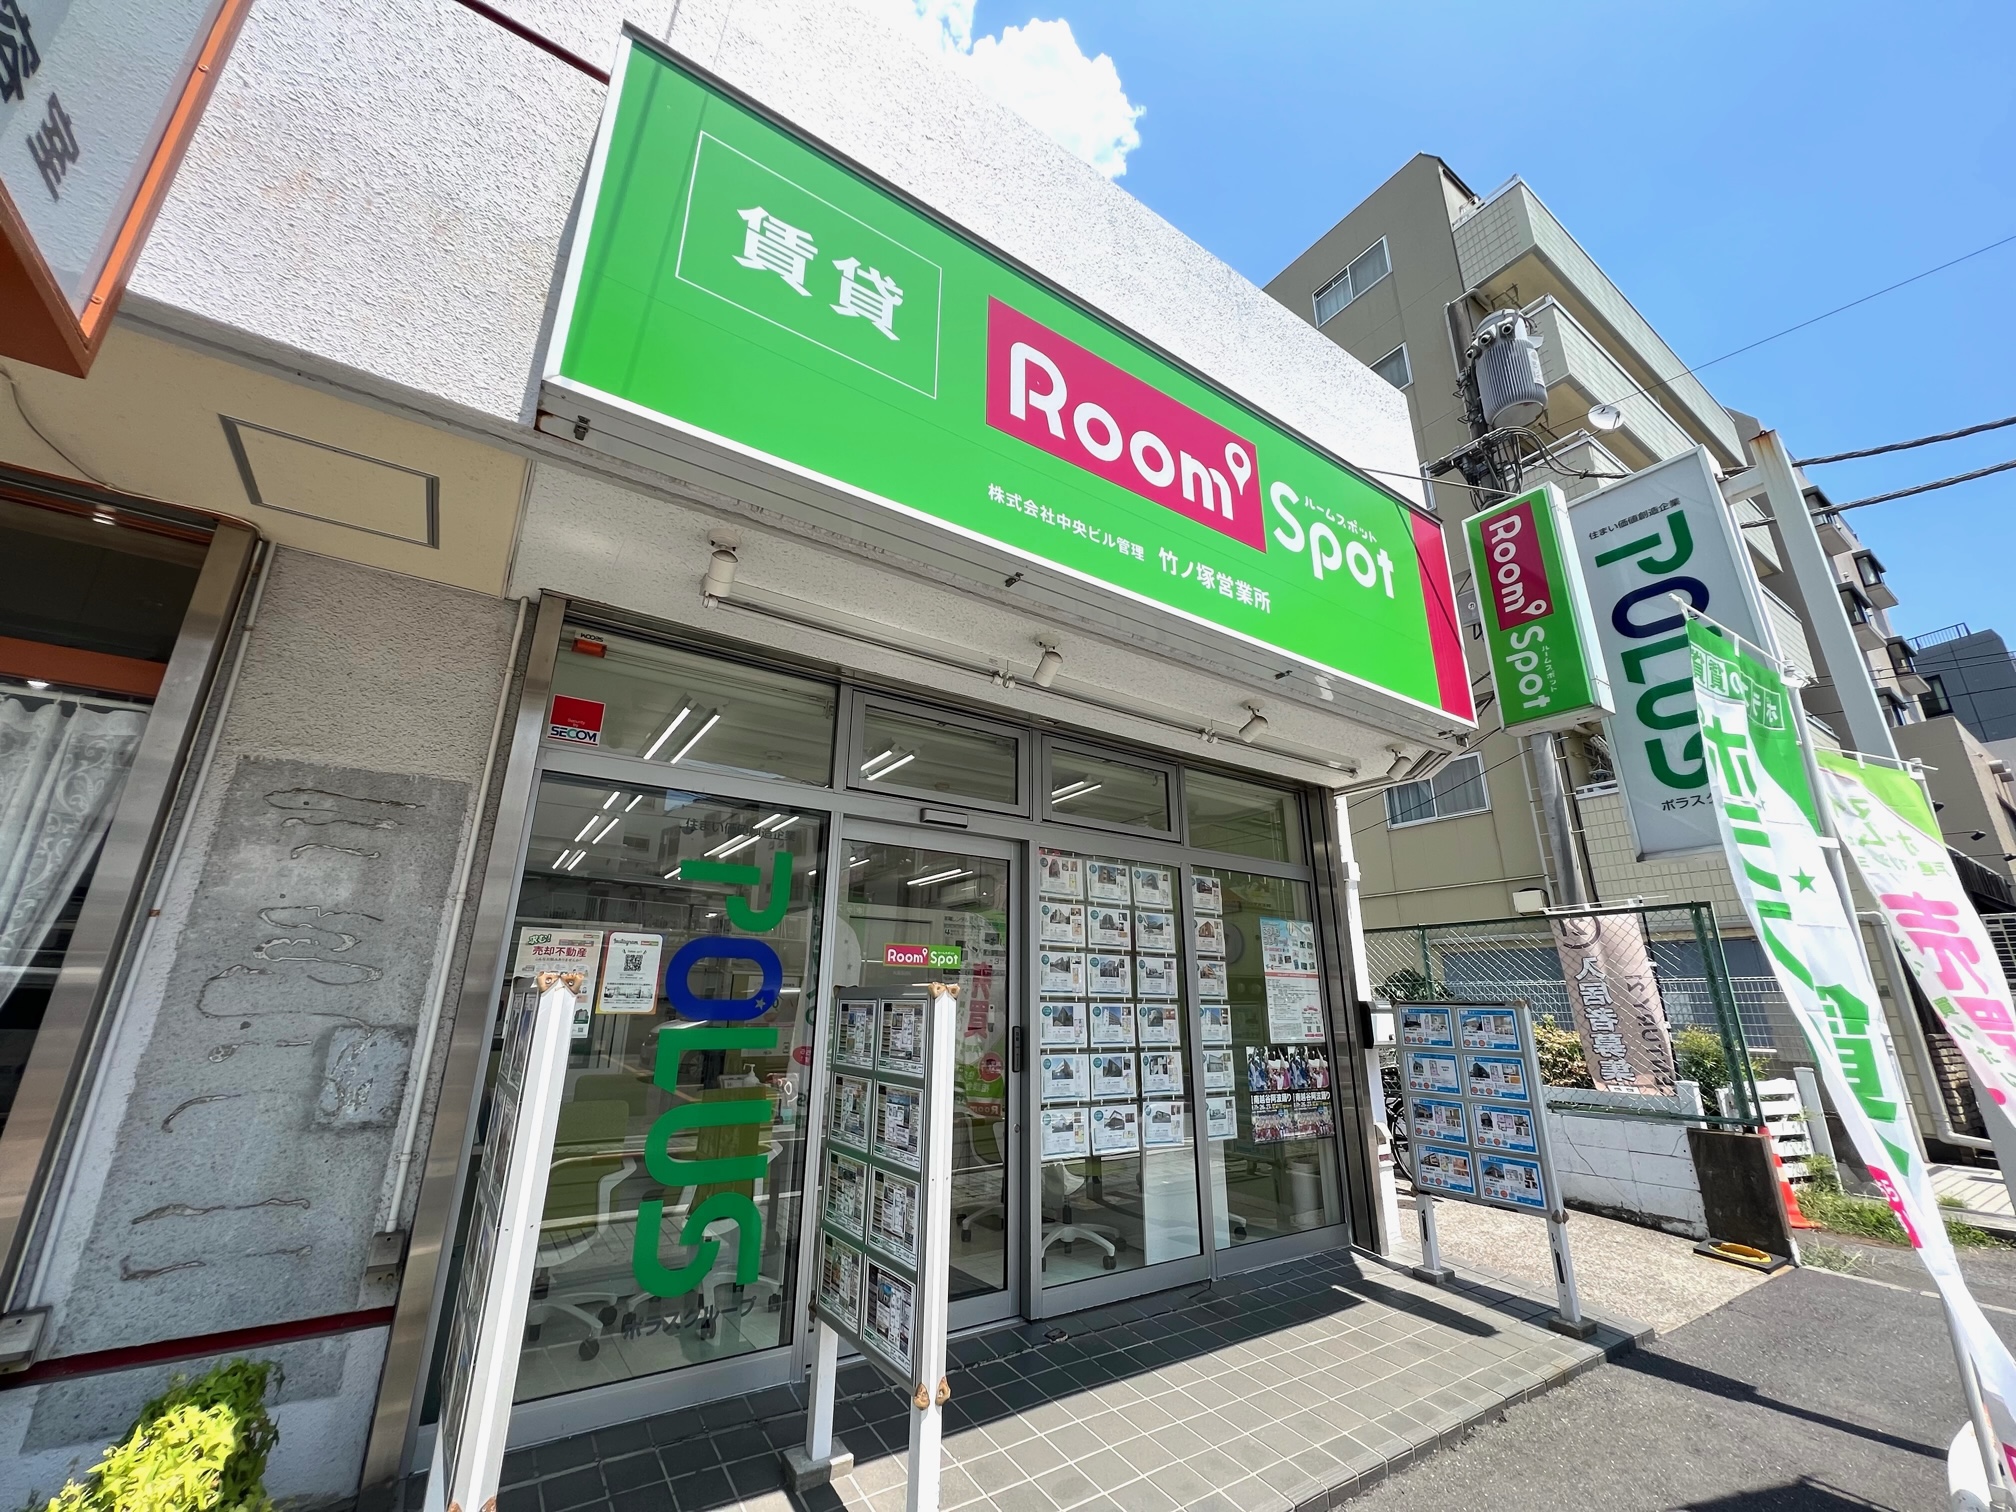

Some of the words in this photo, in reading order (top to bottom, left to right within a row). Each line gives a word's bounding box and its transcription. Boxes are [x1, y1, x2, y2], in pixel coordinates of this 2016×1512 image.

[732, 206, 904, 341] 賃貸
[1009, 341, 1236, 522] Room
[987, 482, 1146, 562] 株式会社中央ビル管理
[1158, 546, 1272, 614] 竹ノ塚営業所
[1269, 481, 1395, 600] Spot
[1304, 495, 1378, 543] ルームスポット
[1488, 514, 1526, 613] Room
[1588, 497, 1681, 541] 住まい価値創造企業
[1505, 625, 1551, 710] Spot
[1541, 645, 1558, 693] ルームスポット
[1594, 510, 1722, 790] POLUS
[550, 726, 598, 743] SECOM
[532, 946, 588, 958] 売却不動産
[887, 948, 924, 964] Room
[930, 951, 959, 967] Spot
[632, 852, 793, 1298] POLUS
